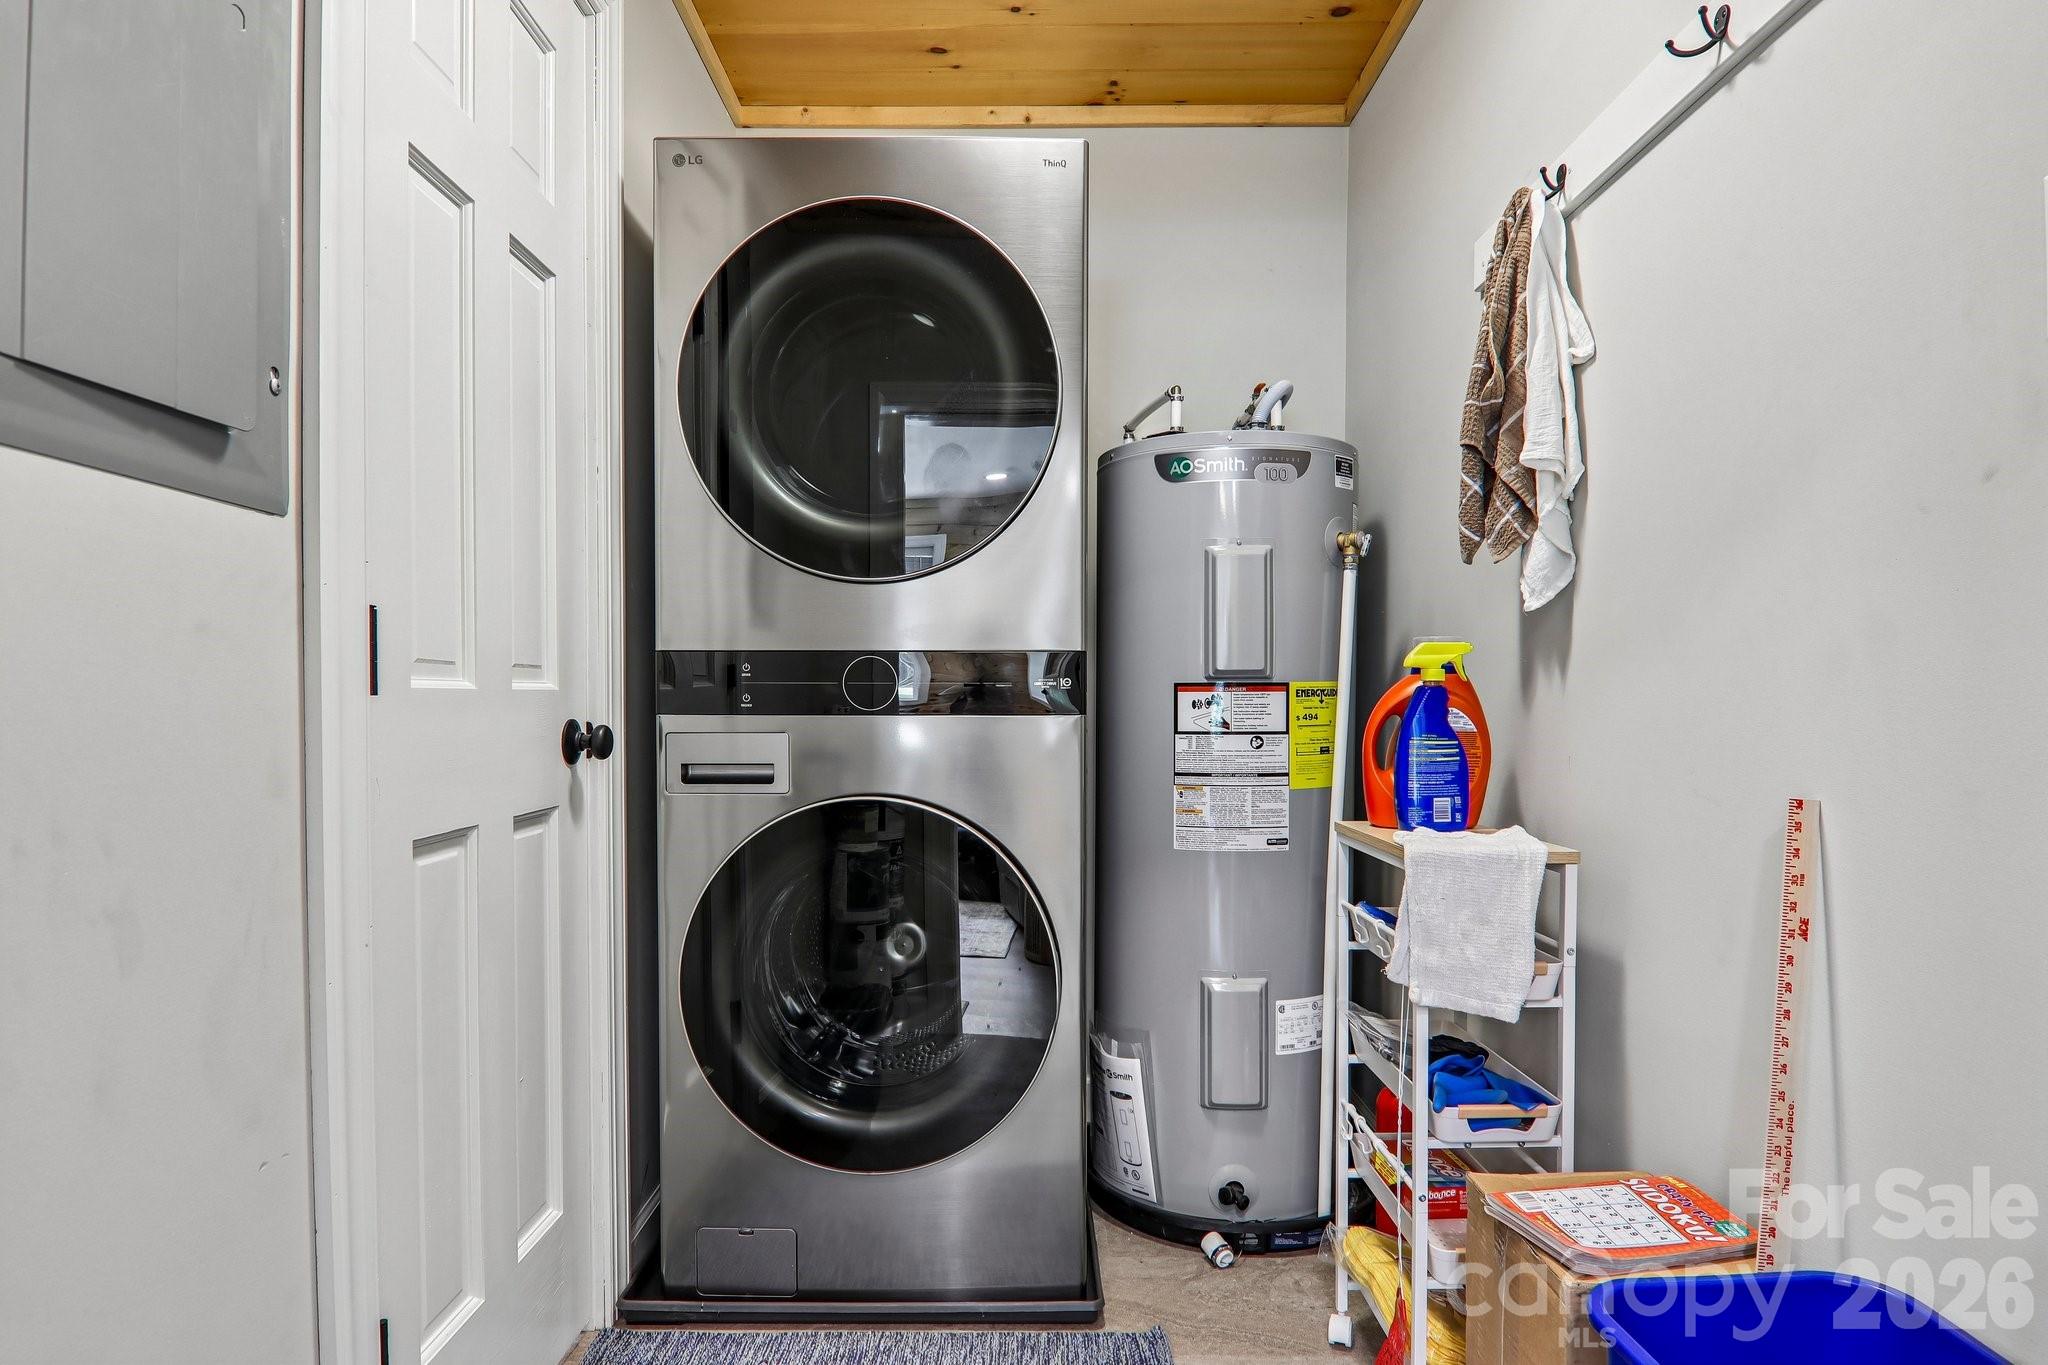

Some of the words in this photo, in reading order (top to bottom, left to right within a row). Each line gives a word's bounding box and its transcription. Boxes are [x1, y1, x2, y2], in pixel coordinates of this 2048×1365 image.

[688, 155, 703, 165] LG
[1042, 159, 1067, 168] ThinQ
[1264, 467, 1288, 481] 100
[1302, 713, 1319, 721] 494
[1794, 821, 1802, 833] 35
[1793, 848, 1801, 860] 34
[1791, 874, 1799, 887] 33
[1790, 901, 1797, 913] 32
[1788, 929, 1796, 940] 31
[1797, 917, 1810, 942] ACE
[1786, 955, 1794, 967] 30
[1785, 982, 1792, 994] 29
[1783, 1009, 1791, 1021] 28
[1782, 1036, 1789, 1048] 27
[1780, 1063, 1788, 1075] 26
[1778, 1090, 1786, 1103] 25
[1786, 1100, 1795, 1133] place.
[1776, 1117, 1784, 1130] 24
[1774, 1145, 1782, 1157] 23
[1783, 1136, 1793, 1174] helpful
[1773, 1172, 1780, 1184] 22
[1781, 1176, 1791, 1196] The
[1619, 1178, 1729, 1242] SUDOKU!
[1770, 1200, 1778, 1212] 21
[1768, 1226, 1776, 1239] 20
[1766, 1254, 1774, 1266] 19
